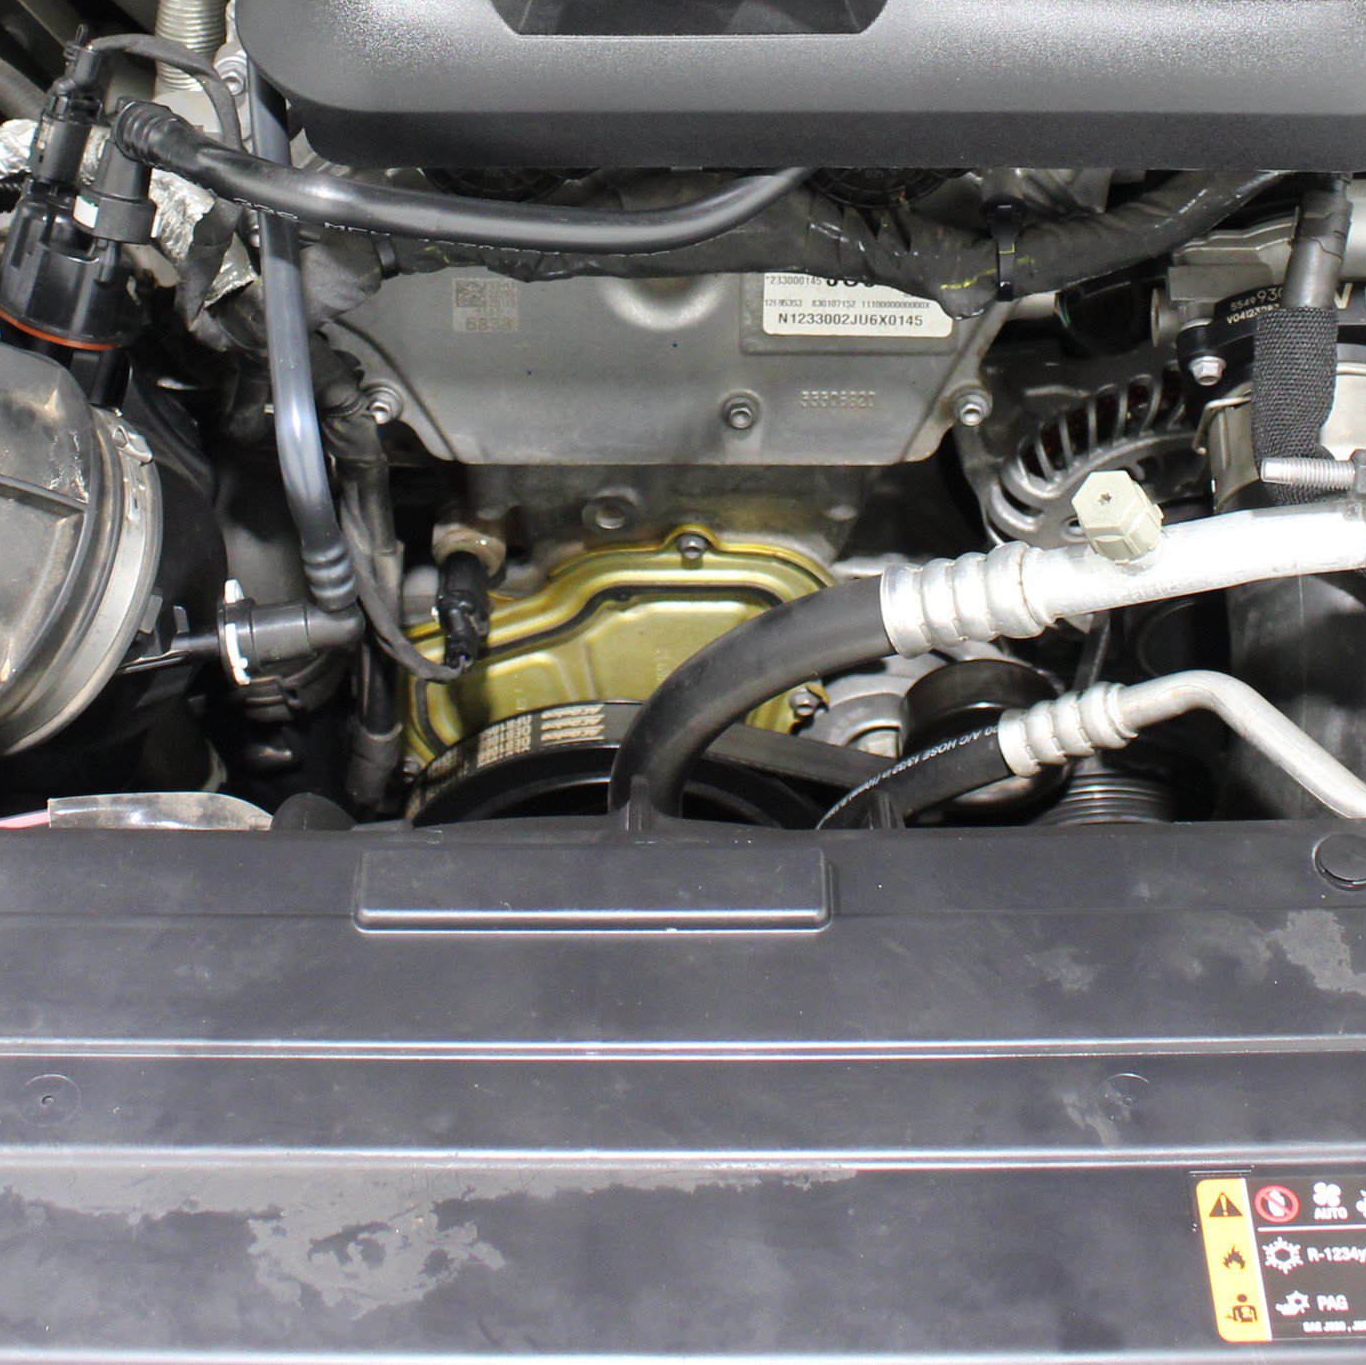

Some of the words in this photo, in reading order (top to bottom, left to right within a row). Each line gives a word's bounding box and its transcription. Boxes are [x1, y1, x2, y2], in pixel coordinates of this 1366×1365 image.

[778, 312, 924, 327] N1233002JU6X0145
[921, 740, 957, 761] HOSE
[1313, 1206, 1349, 1221] AUTO
[1316, 1294, 1349, 1311] PAG
